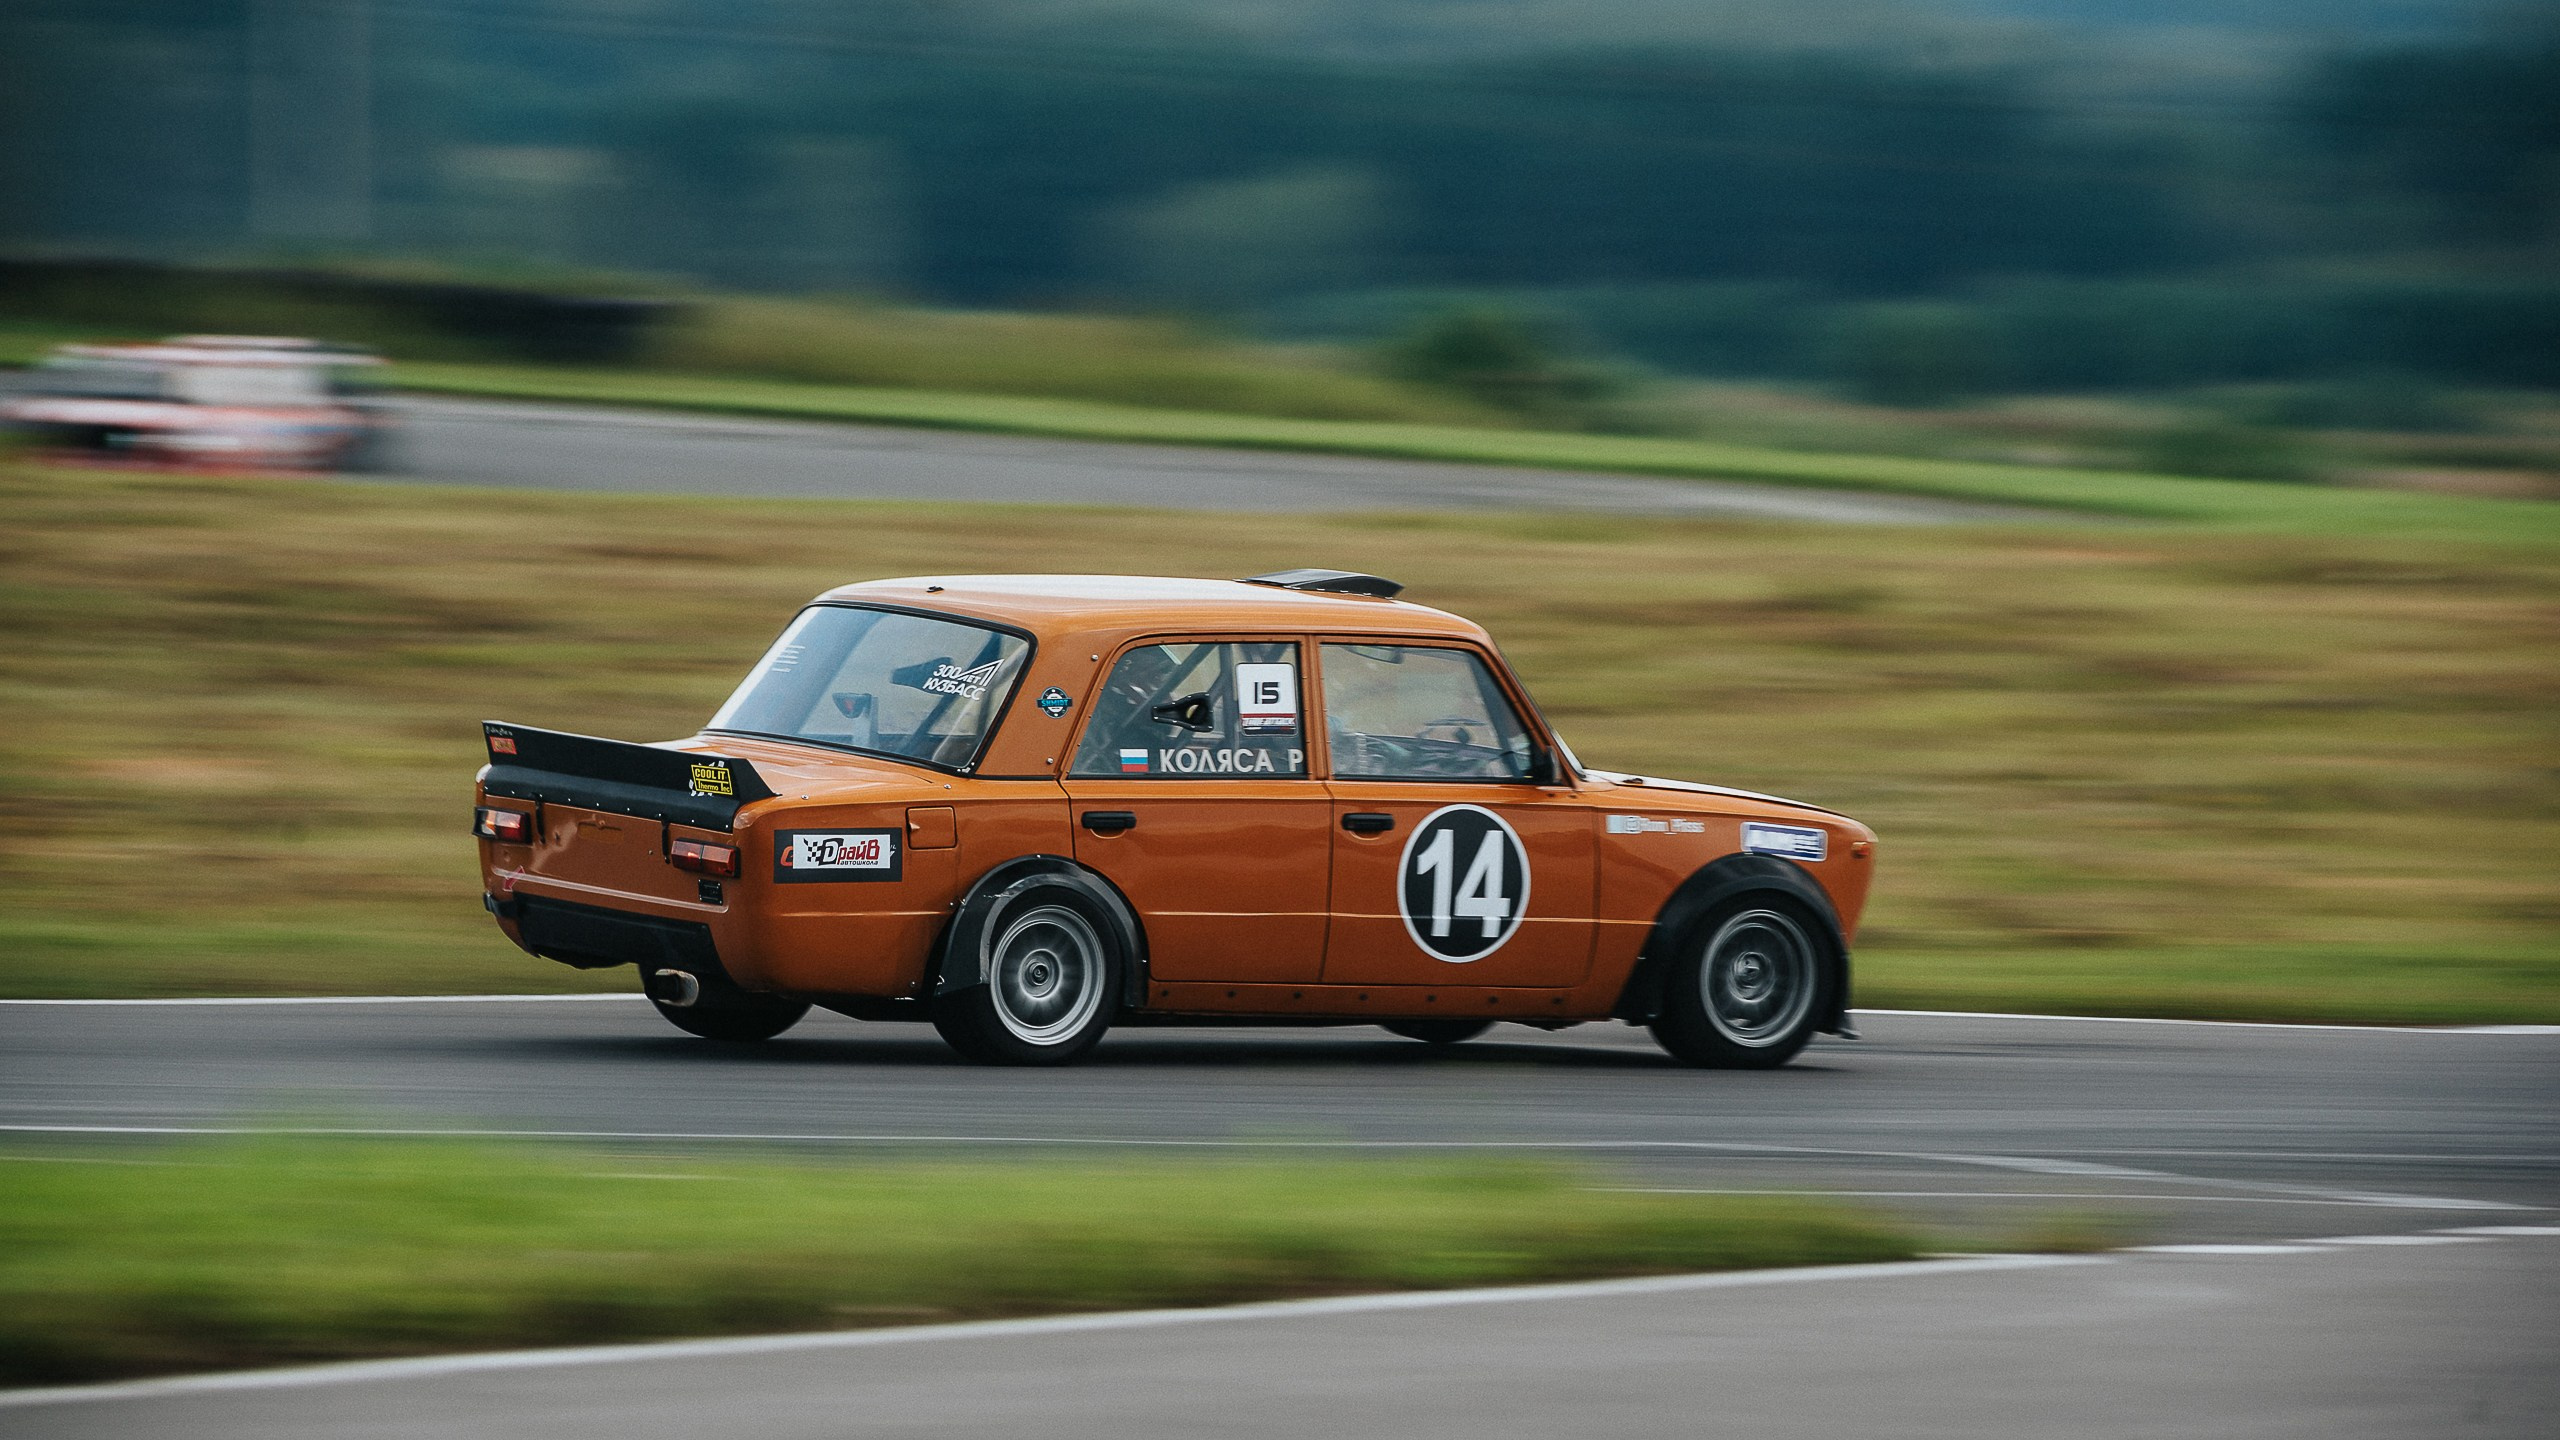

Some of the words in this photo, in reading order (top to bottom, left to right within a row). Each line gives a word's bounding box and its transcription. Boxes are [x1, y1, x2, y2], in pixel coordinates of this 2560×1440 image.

[933, 664, 962, 680] 300
[1254, 681, 1280, 704] 15
[1159, 749, 1275, 773] КОЛЯСА
[694, 768, 717, 780] COOL
[717, 769, 726, 780] IT
[697, 780, 719, 791] Thermo
[720, 782, 731, 793] Tec
[1416, 828, 1511, 938] 14
